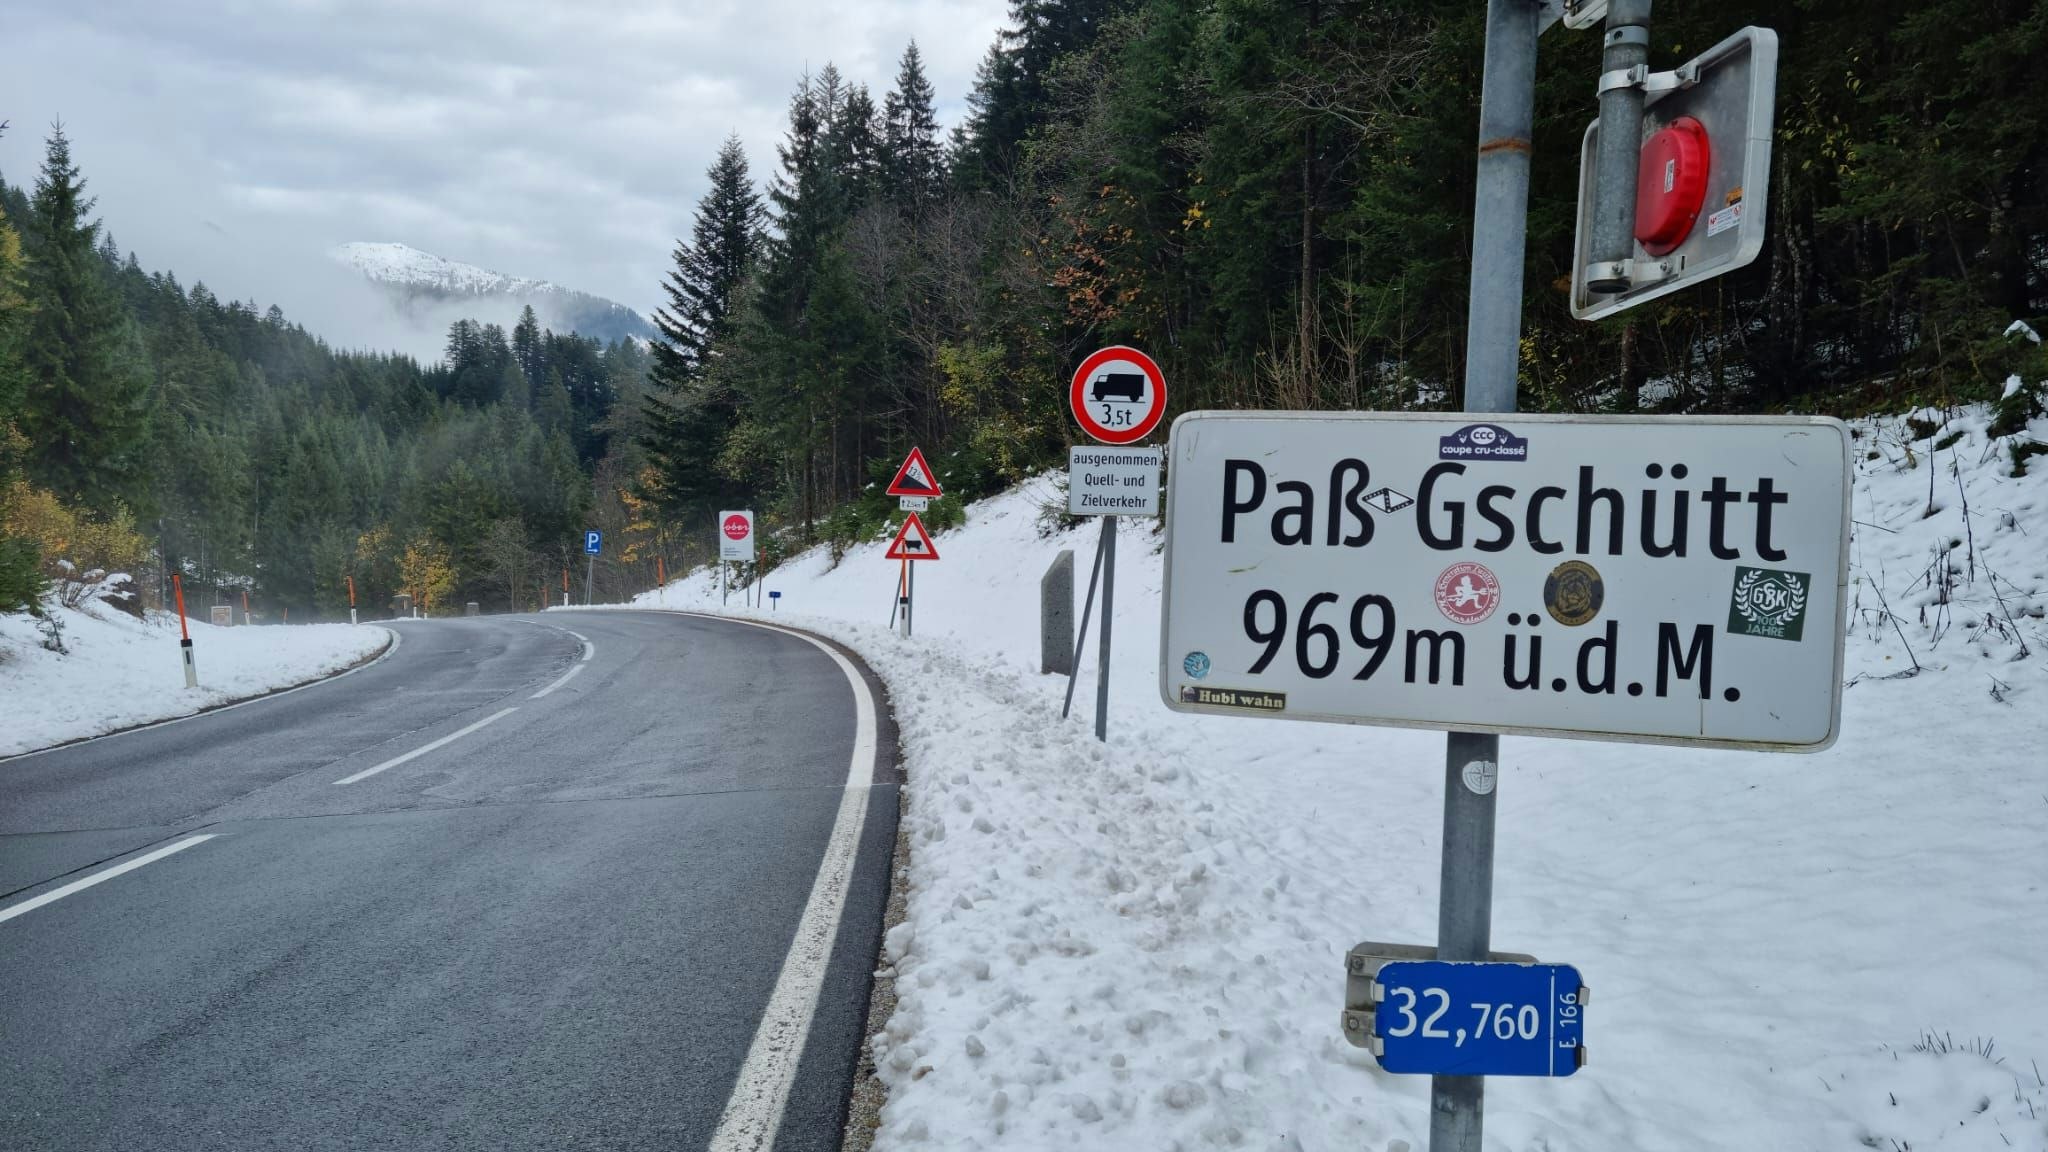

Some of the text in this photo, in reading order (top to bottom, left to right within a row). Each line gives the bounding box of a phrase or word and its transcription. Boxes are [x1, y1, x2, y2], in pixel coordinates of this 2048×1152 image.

[1101, 403, 1132, 427] 3,5t
[1473, 431, 1494, 440] CCC
[1442, 445, 1525, 456] coupe cru-classé
[1073, 453, 1158, 467] ausgenommen
[1084, 473, 1145, 487] Quell- und
[1081, 494, 1147, 508] Zielverkehr
[1222, 458, 1789, 562] Paß Gschütt
[588, 532, 599, 549] P
[1757, 616, 1777, 626] 100
[1746, 624, 1785, 636] JAHRE
[1243, 588, 1742, 703] 969m ü.d.M.
[1240, 696, 1284, 709] wahn
[1388, 986, 1540, 1048] 32,760
[1559, 992, 1578, 1049] E 166
